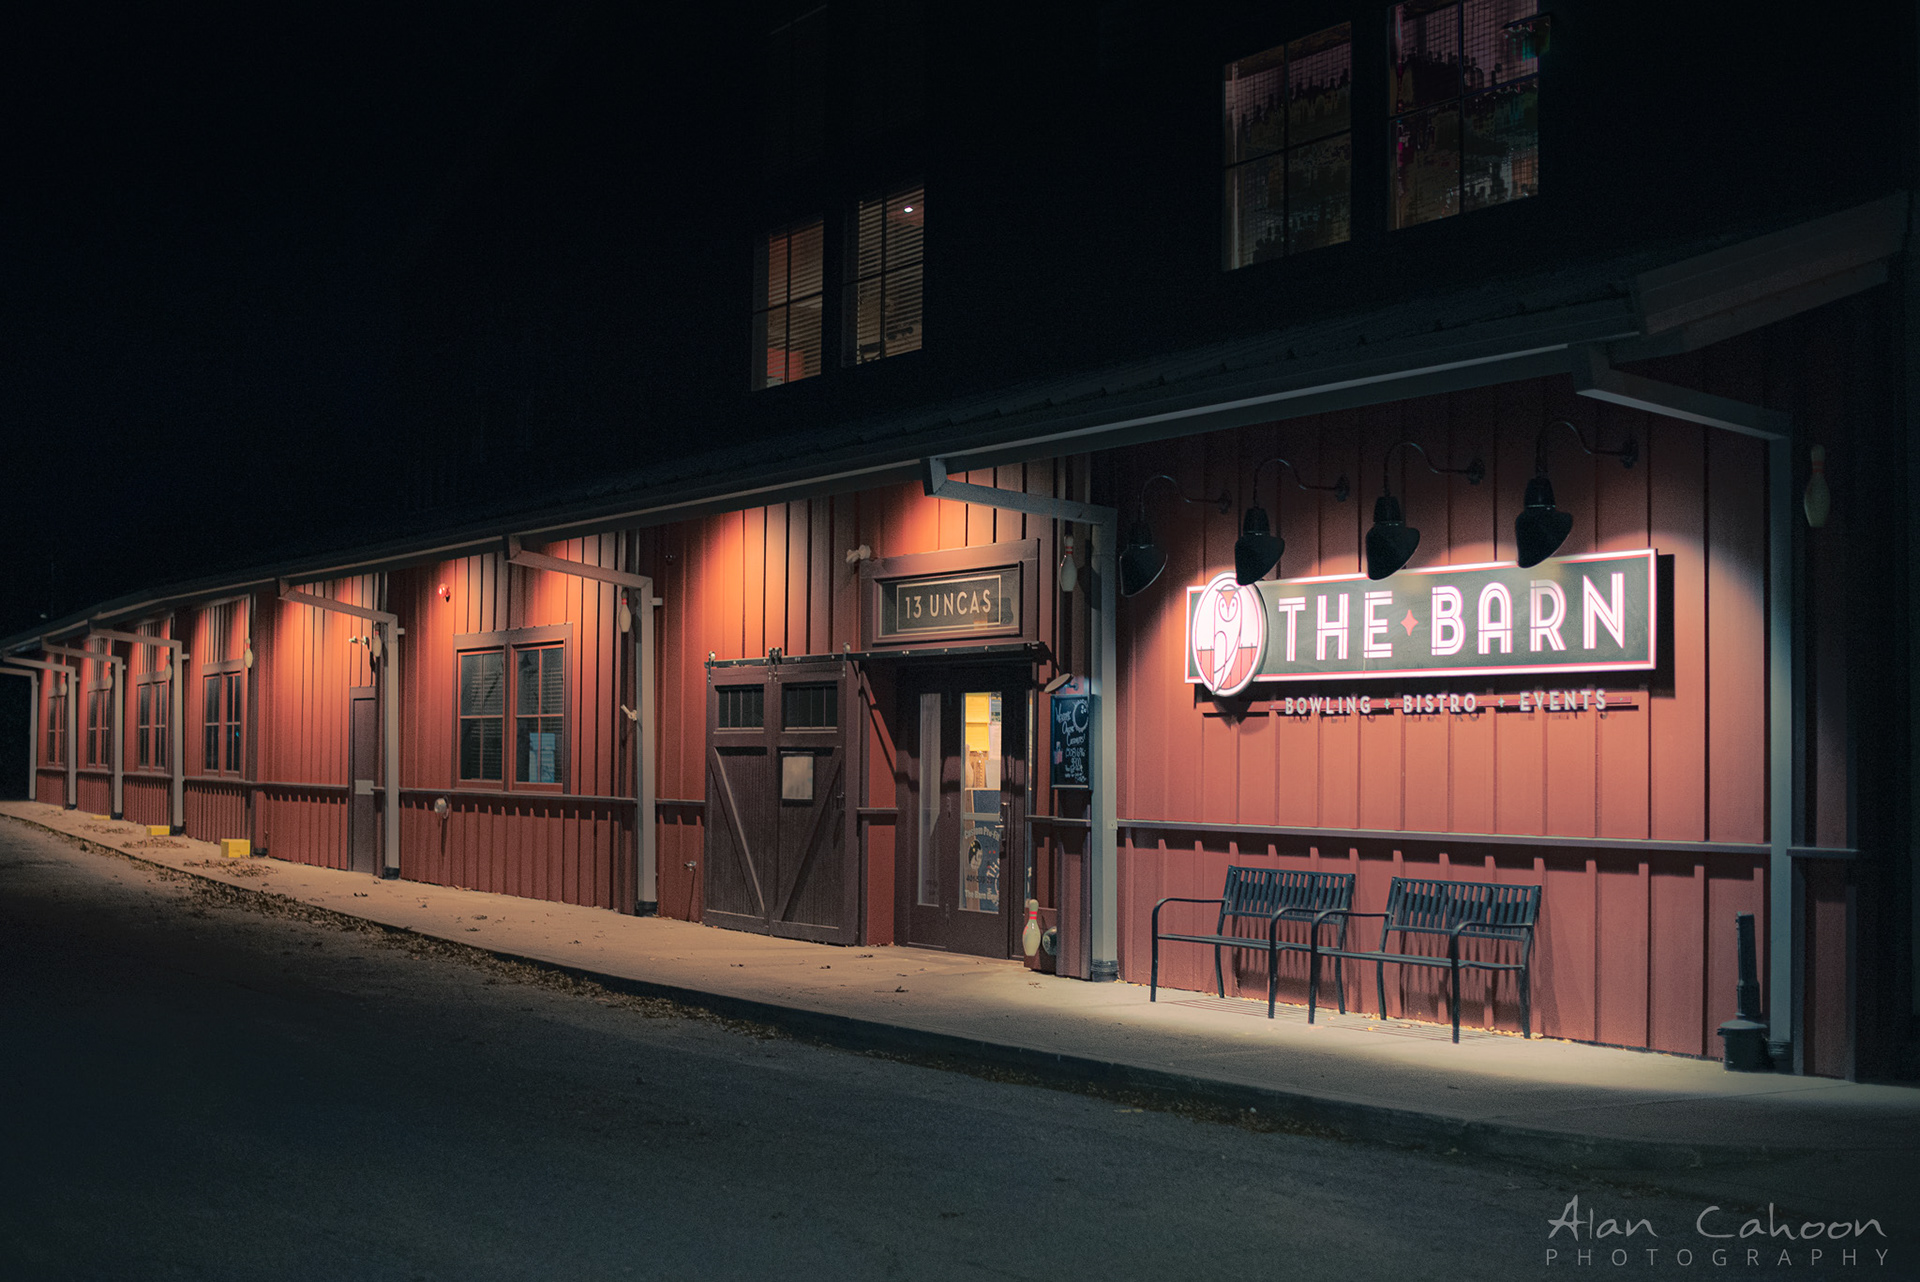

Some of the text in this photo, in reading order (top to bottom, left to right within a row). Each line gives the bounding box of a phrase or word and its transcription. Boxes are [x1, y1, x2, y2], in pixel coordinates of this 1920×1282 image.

[905, 589, 991, 619] 13 UNCAS
[1278, 572, 1625, 662] THE BARN
[1284, 690, 1607, 716] BOWLING BISTRO EVENTS
